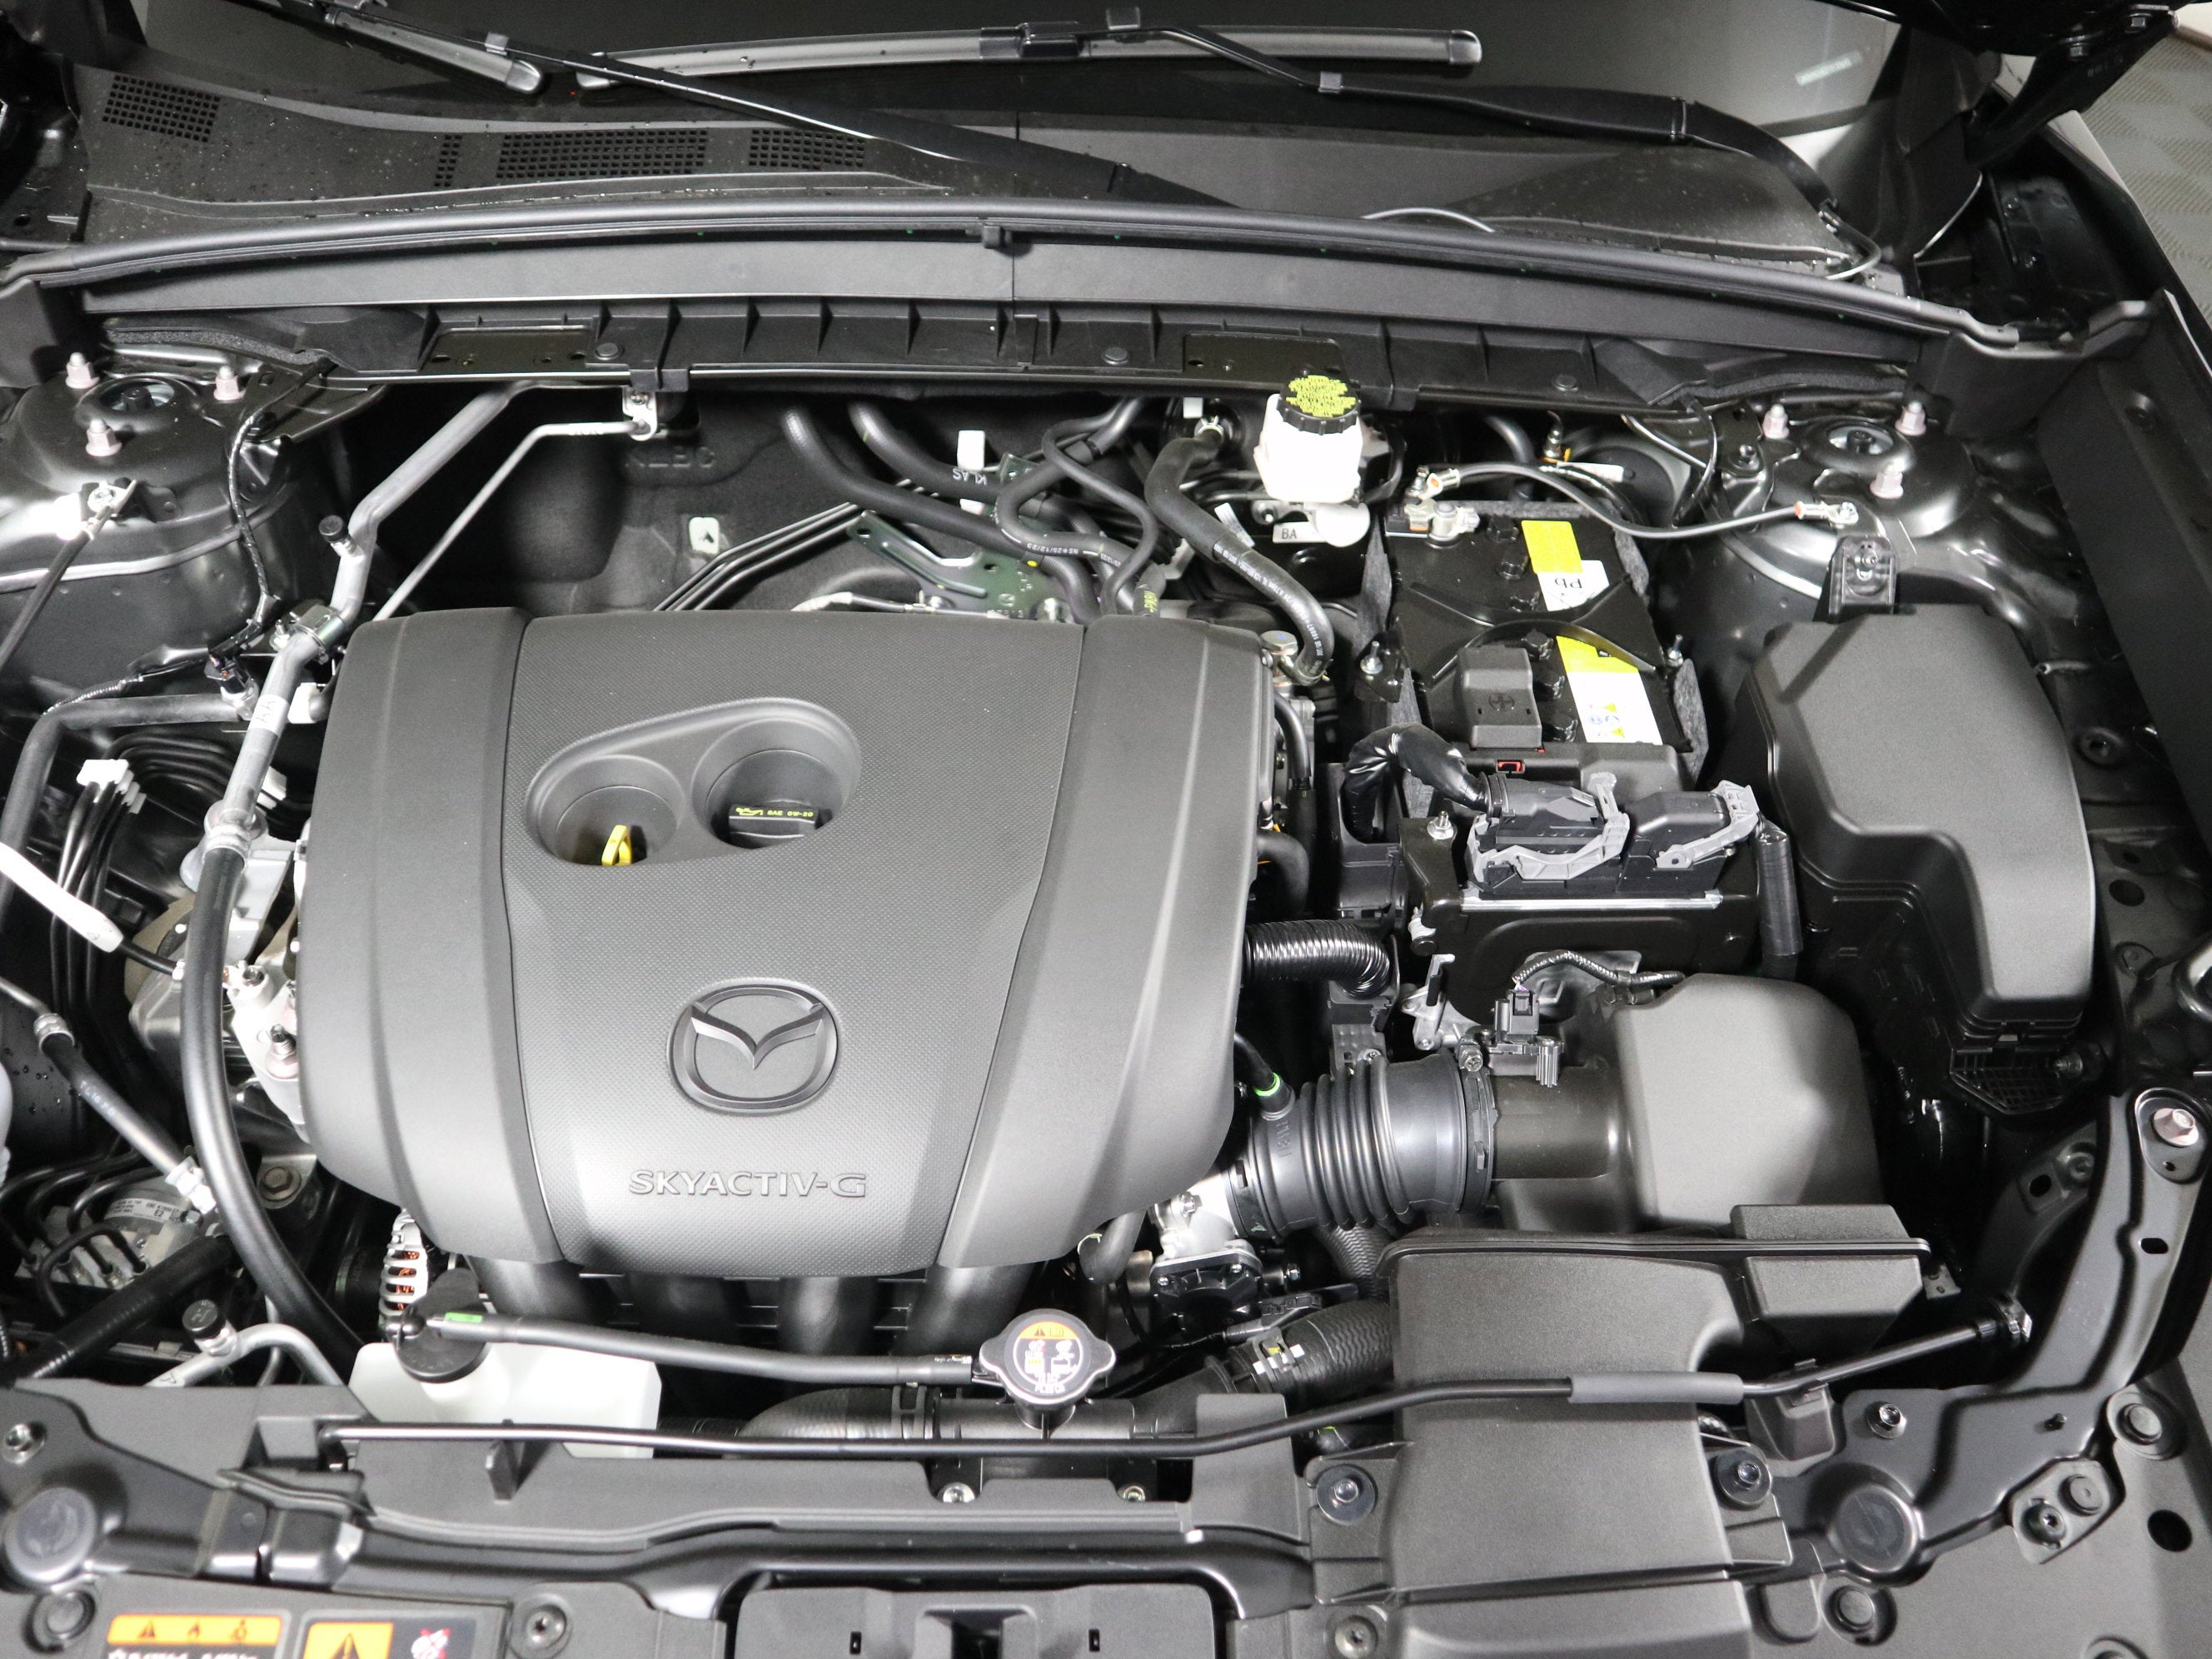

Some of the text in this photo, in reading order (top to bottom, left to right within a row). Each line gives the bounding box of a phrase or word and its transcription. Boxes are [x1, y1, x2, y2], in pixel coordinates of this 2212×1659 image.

[1281, 527, 1298, 540] BA
[1554, 577, 1582, 589] Pb
[629, 1169, 867, 1198] SKYACTIV-G
